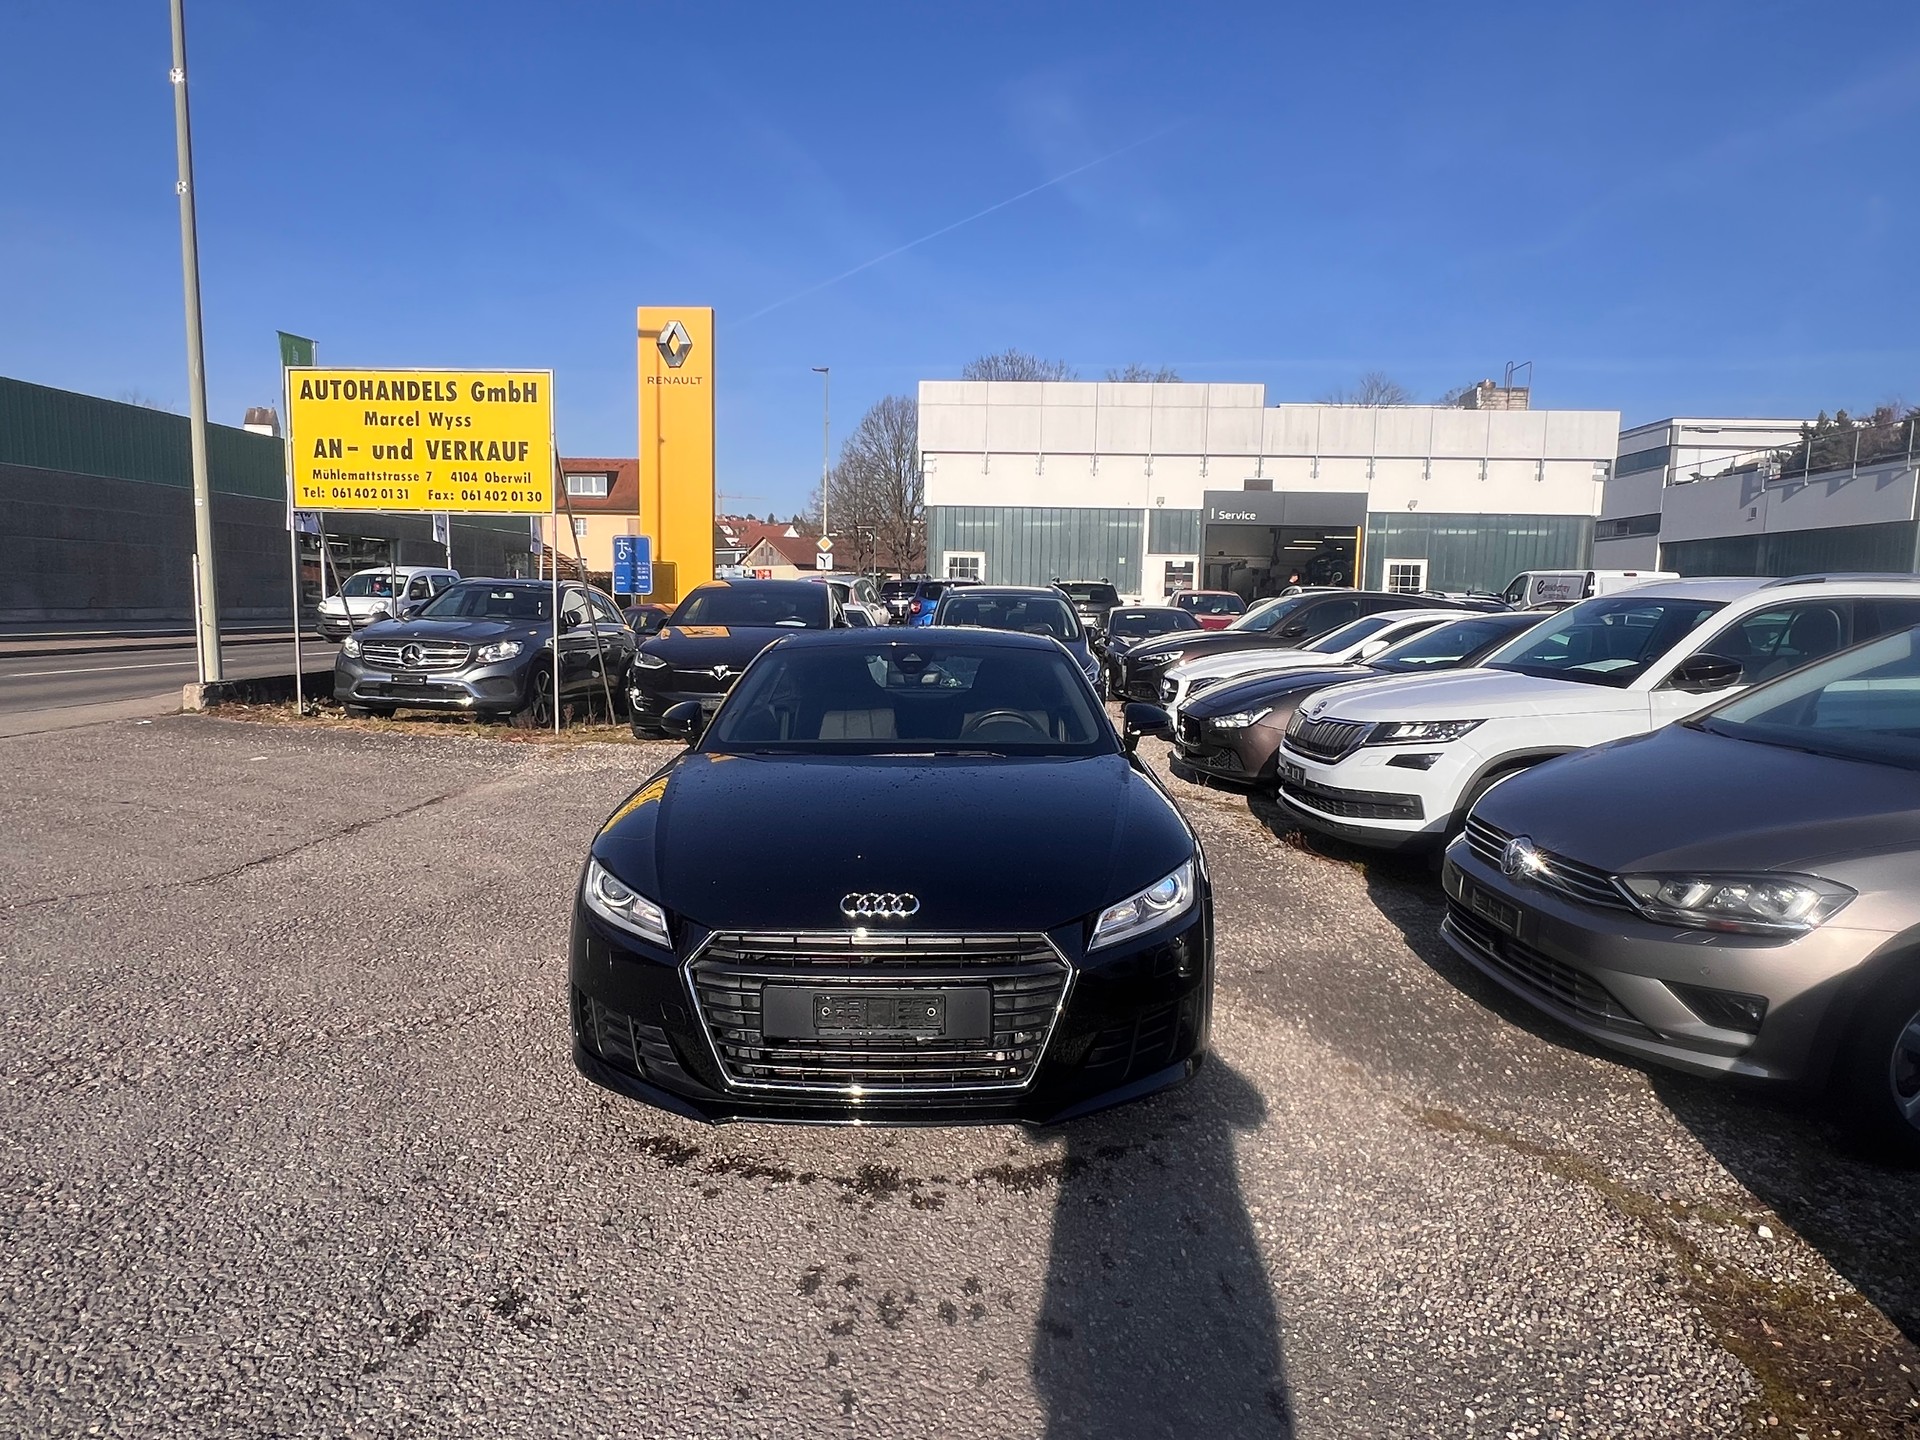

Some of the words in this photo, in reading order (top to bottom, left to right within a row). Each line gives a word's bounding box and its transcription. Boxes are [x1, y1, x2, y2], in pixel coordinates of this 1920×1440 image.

[646, 376, 703, 385] RENAULT
[299, 379, 458, 402] AUTOHANDELS
[470, 380, 538, 403] GmbH
[364, 410, 420, 427] Marcel
[428, 411, 472, 431] Wyss
[372, 437, 413, 460] und
[425, 439, 529, 462] VERKAUF
[312, 468, 420, 482] Mühlemattstrasse
[425, 471, 433, 482] 7
[450, 471, 478, 483] 4104
[484, 471, 531, 484] Oberwil
[302, 486, 325, 498] Tel:
[428, 489, 455, 501] Fax:
[1218, 510, 1257, 521] Service
